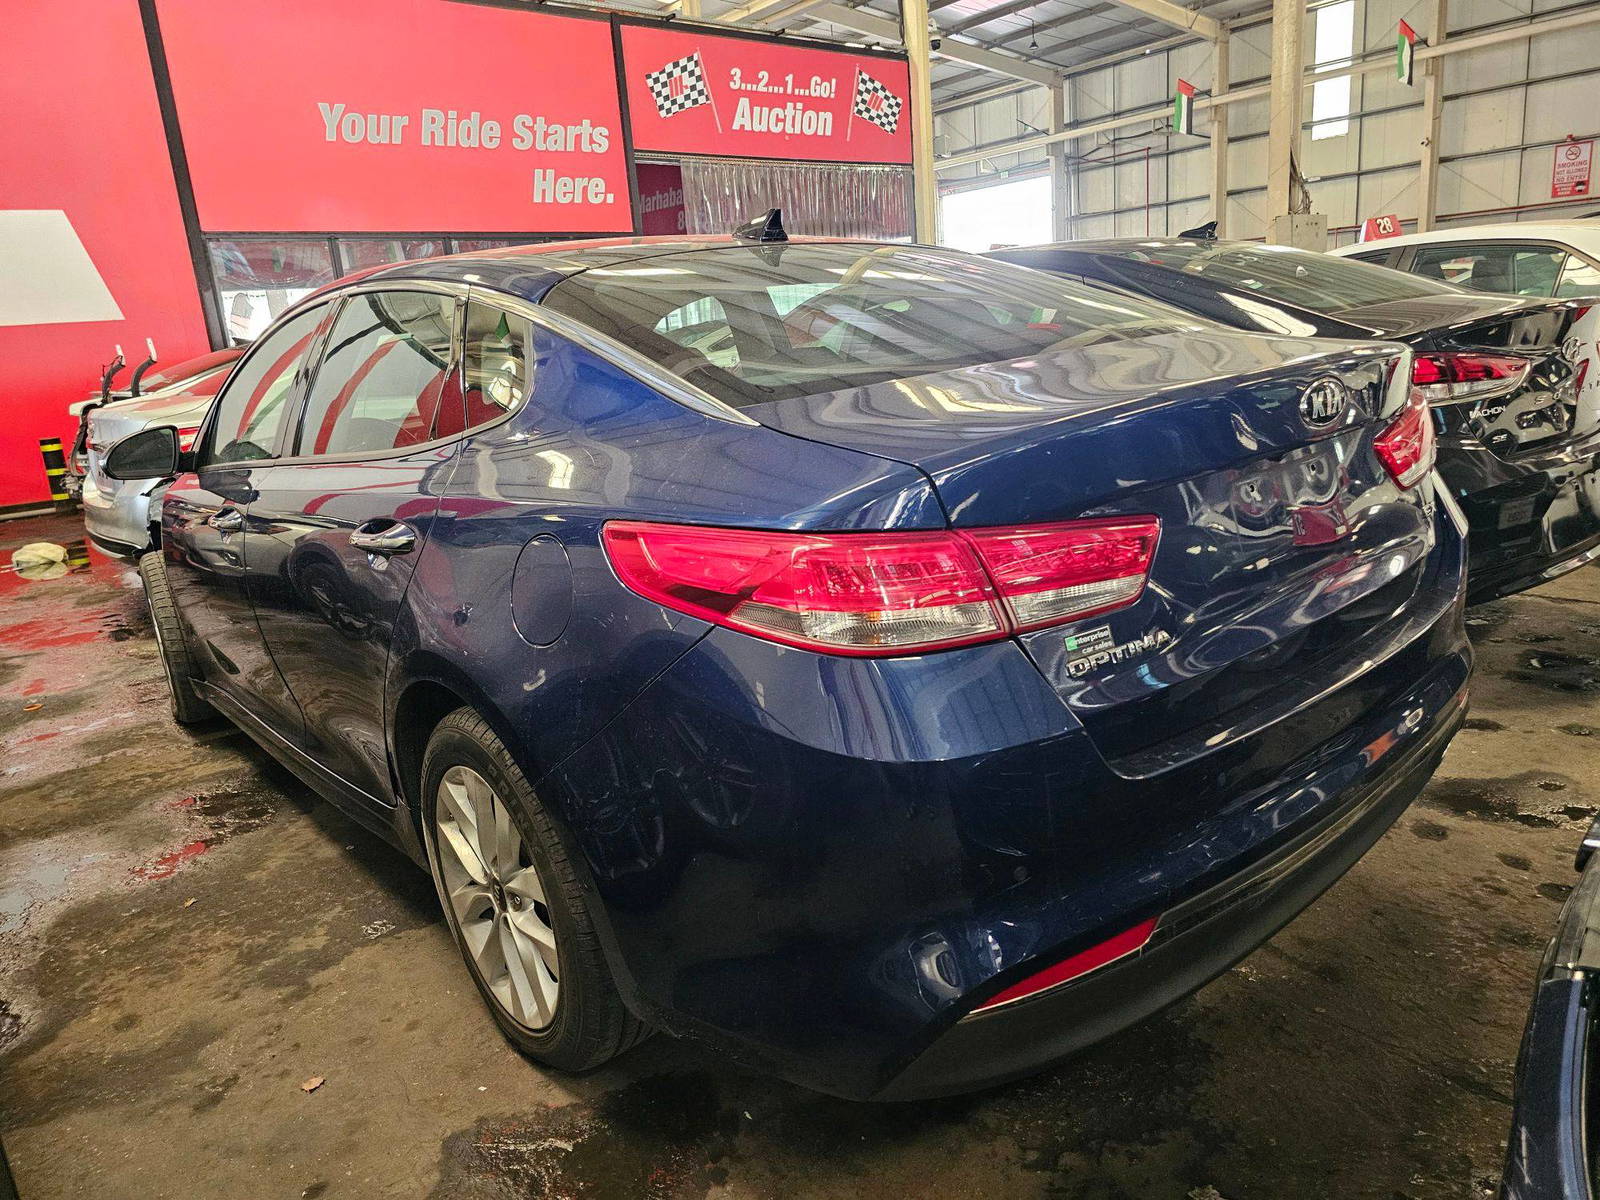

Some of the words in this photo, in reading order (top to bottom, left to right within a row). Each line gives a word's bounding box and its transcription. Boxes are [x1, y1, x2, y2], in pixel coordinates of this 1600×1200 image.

[317, 102, 408, 145] Your
[420, 108, 501, 149] Ride
[512, 114, 609, 153] Starts
[732, 97, 832, 136] Auction
[1557, 160, 1588, 169] SMOKING
[533, 169, 615, 204] Here.
[1376, 217, 1394, 234] 28
[1310, 382, 1343, 419] KIA
[1066, 629, 1172, 678] OPTIMA
[1082, 646, 1096, 654] car
[1095, 639, 1114, 651] sales
